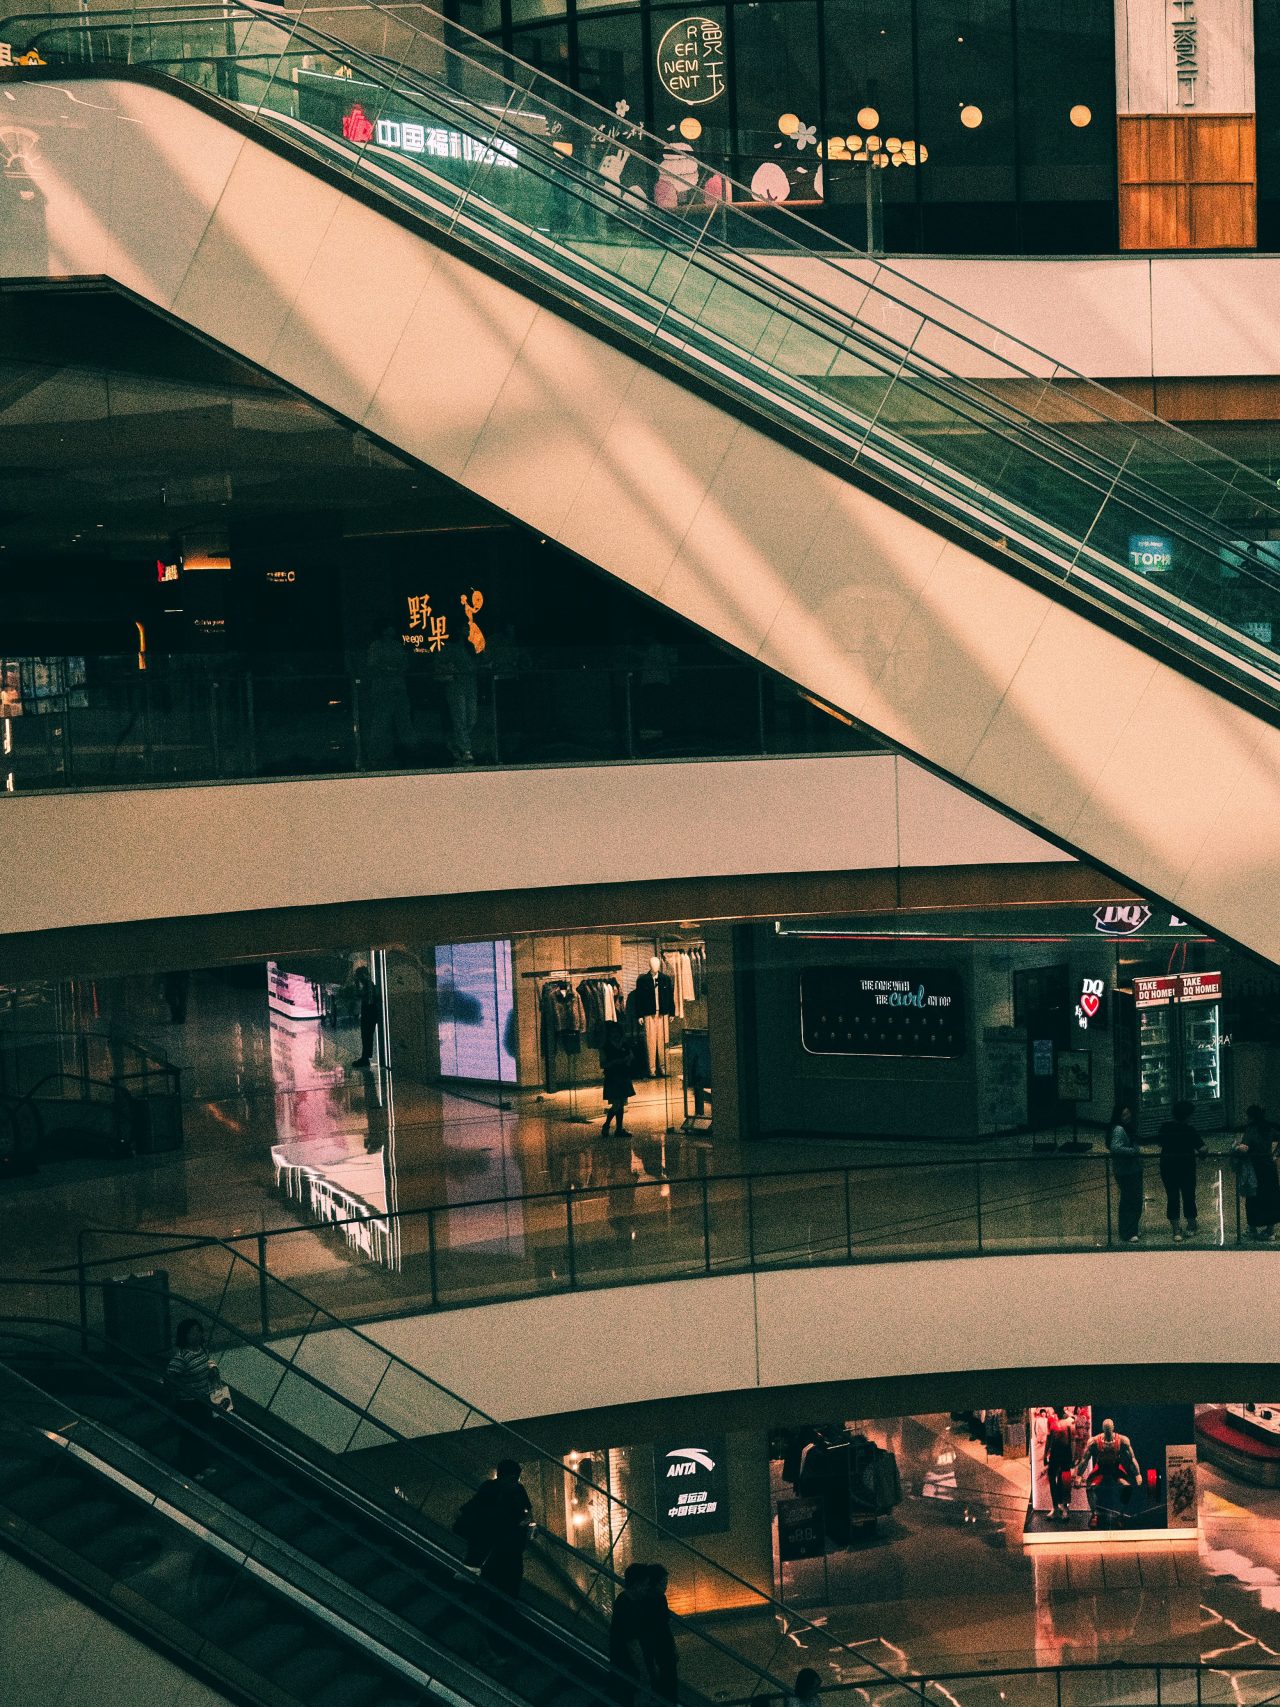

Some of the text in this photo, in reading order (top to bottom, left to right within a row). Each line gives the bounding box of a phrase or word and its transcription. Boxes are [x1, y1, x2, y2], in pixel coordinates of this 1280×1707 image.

[687, 26, 698, 39] R
[674, 41, 698, 57] EFI
[664, 59, 699, 74] NEM
[669, 75, 700, 90] ENT
[407, 593, 450, 653] 野果
[1082, 978, 1105, 998] DQ
[1139, 981, 1158, 991] TAKE
[1183, 976, 1202, 987] TAKE
[1139, 990, 1150, 1000] DQ
[1183, 983, 1219, 996] DQ HOME!
[666, 1461, 696, 1478] ANTA
